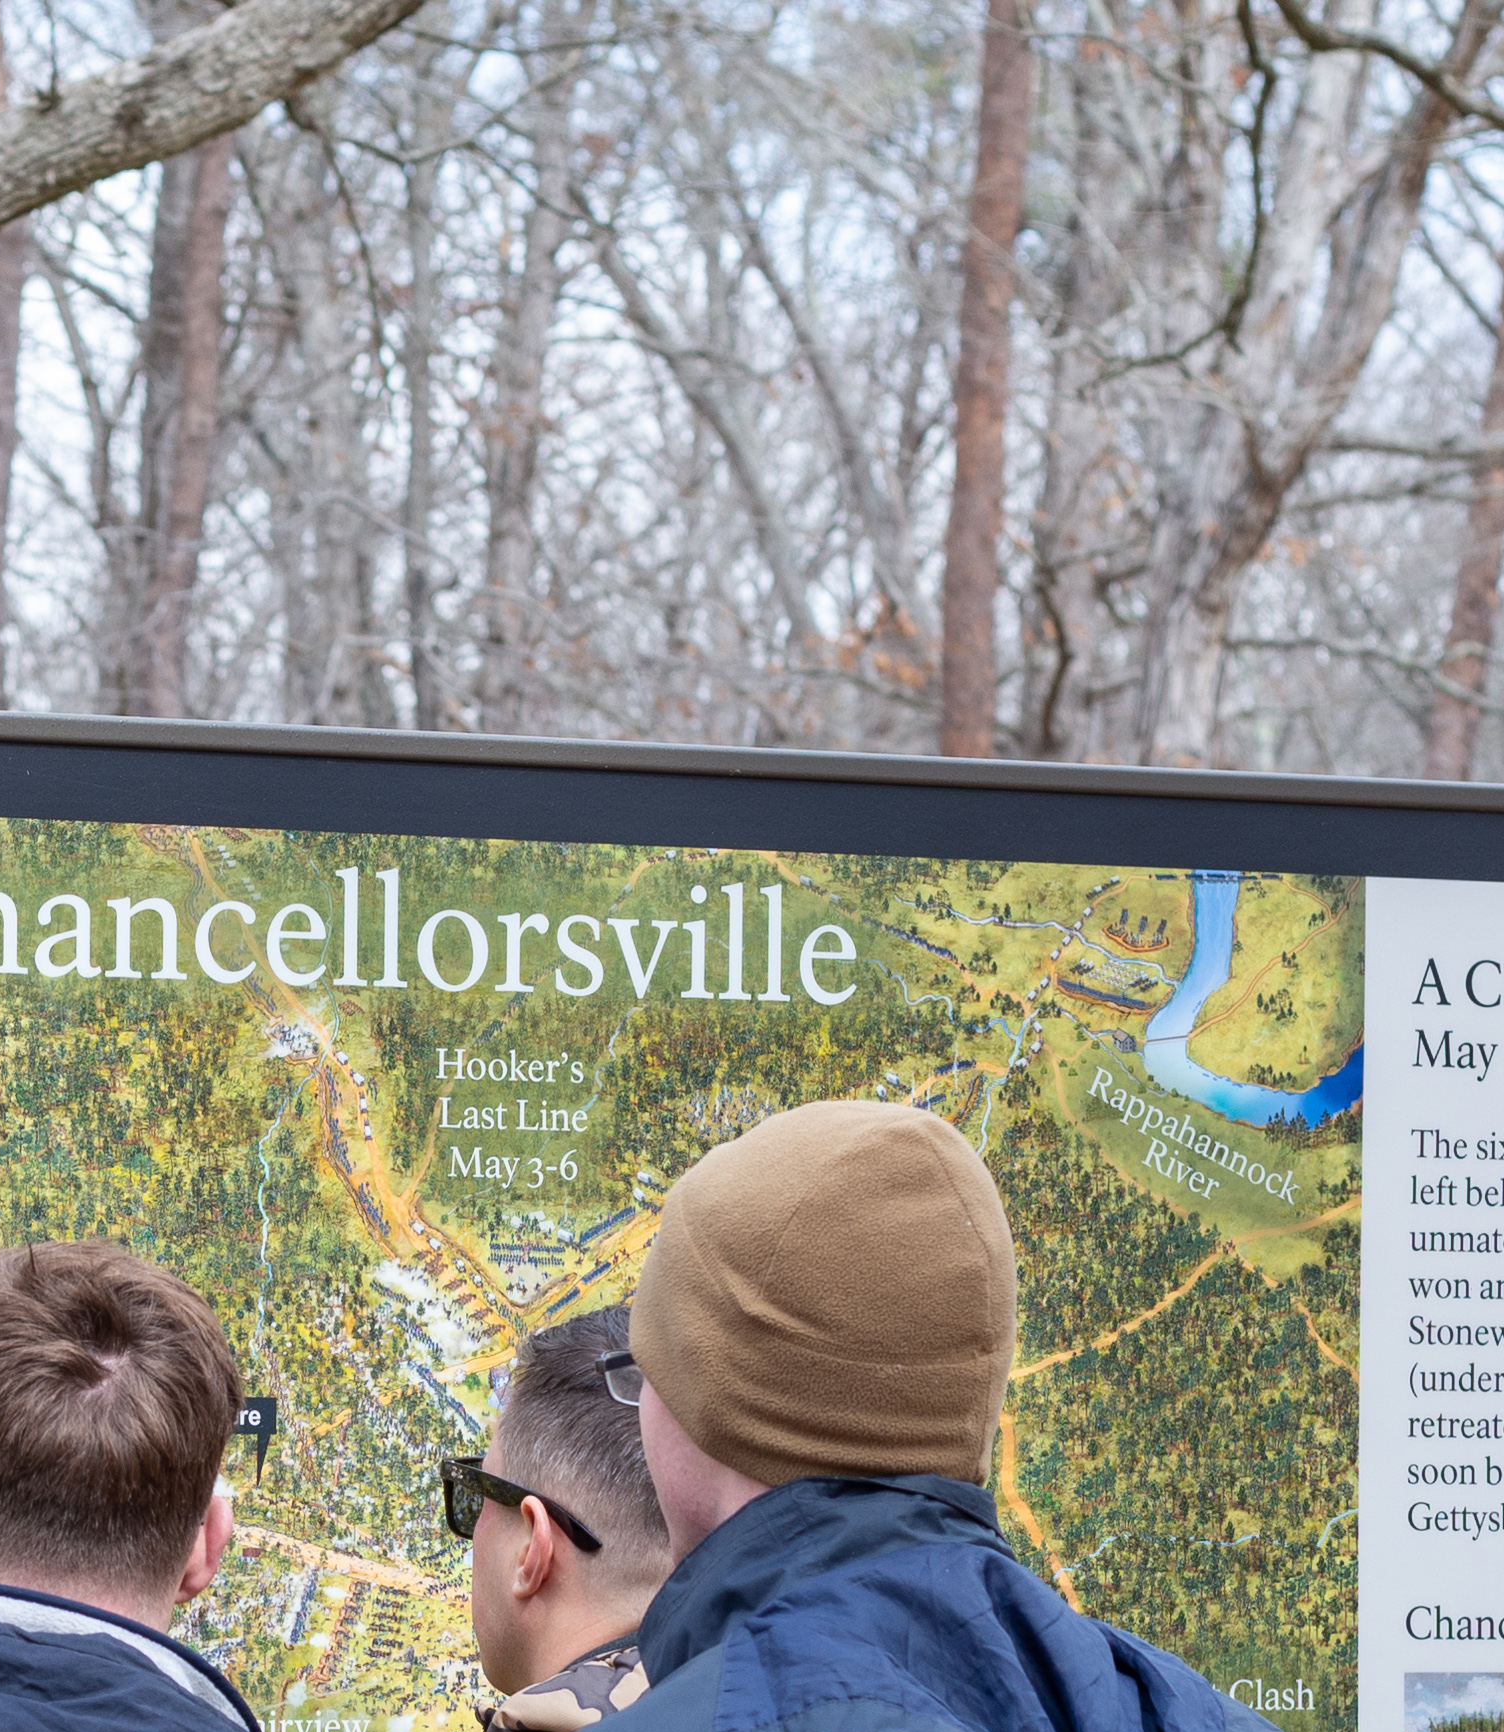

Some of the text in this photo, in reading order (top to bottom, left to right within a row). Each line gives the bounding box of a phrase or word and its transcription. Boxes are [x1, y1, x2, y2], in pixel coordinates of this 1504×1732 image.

[1411, 957, 1452, 1006] A
[435, 1046, 585, 1086] Hooker's
[1412, 1029, 1499, 1083] May
[438, 1095, 589, 1133] Last Line
[1085, 1065, 1301, 1207] Rappahannock
[1410, 1128, 1468, 1160] The
[446, 1146, 579, 1191] May 3-6
[1140, 1138, 1222, 1202] River
[1410, 1174, 1458, 1206] left
[1229, 1678, 1316, 1711] Clash
